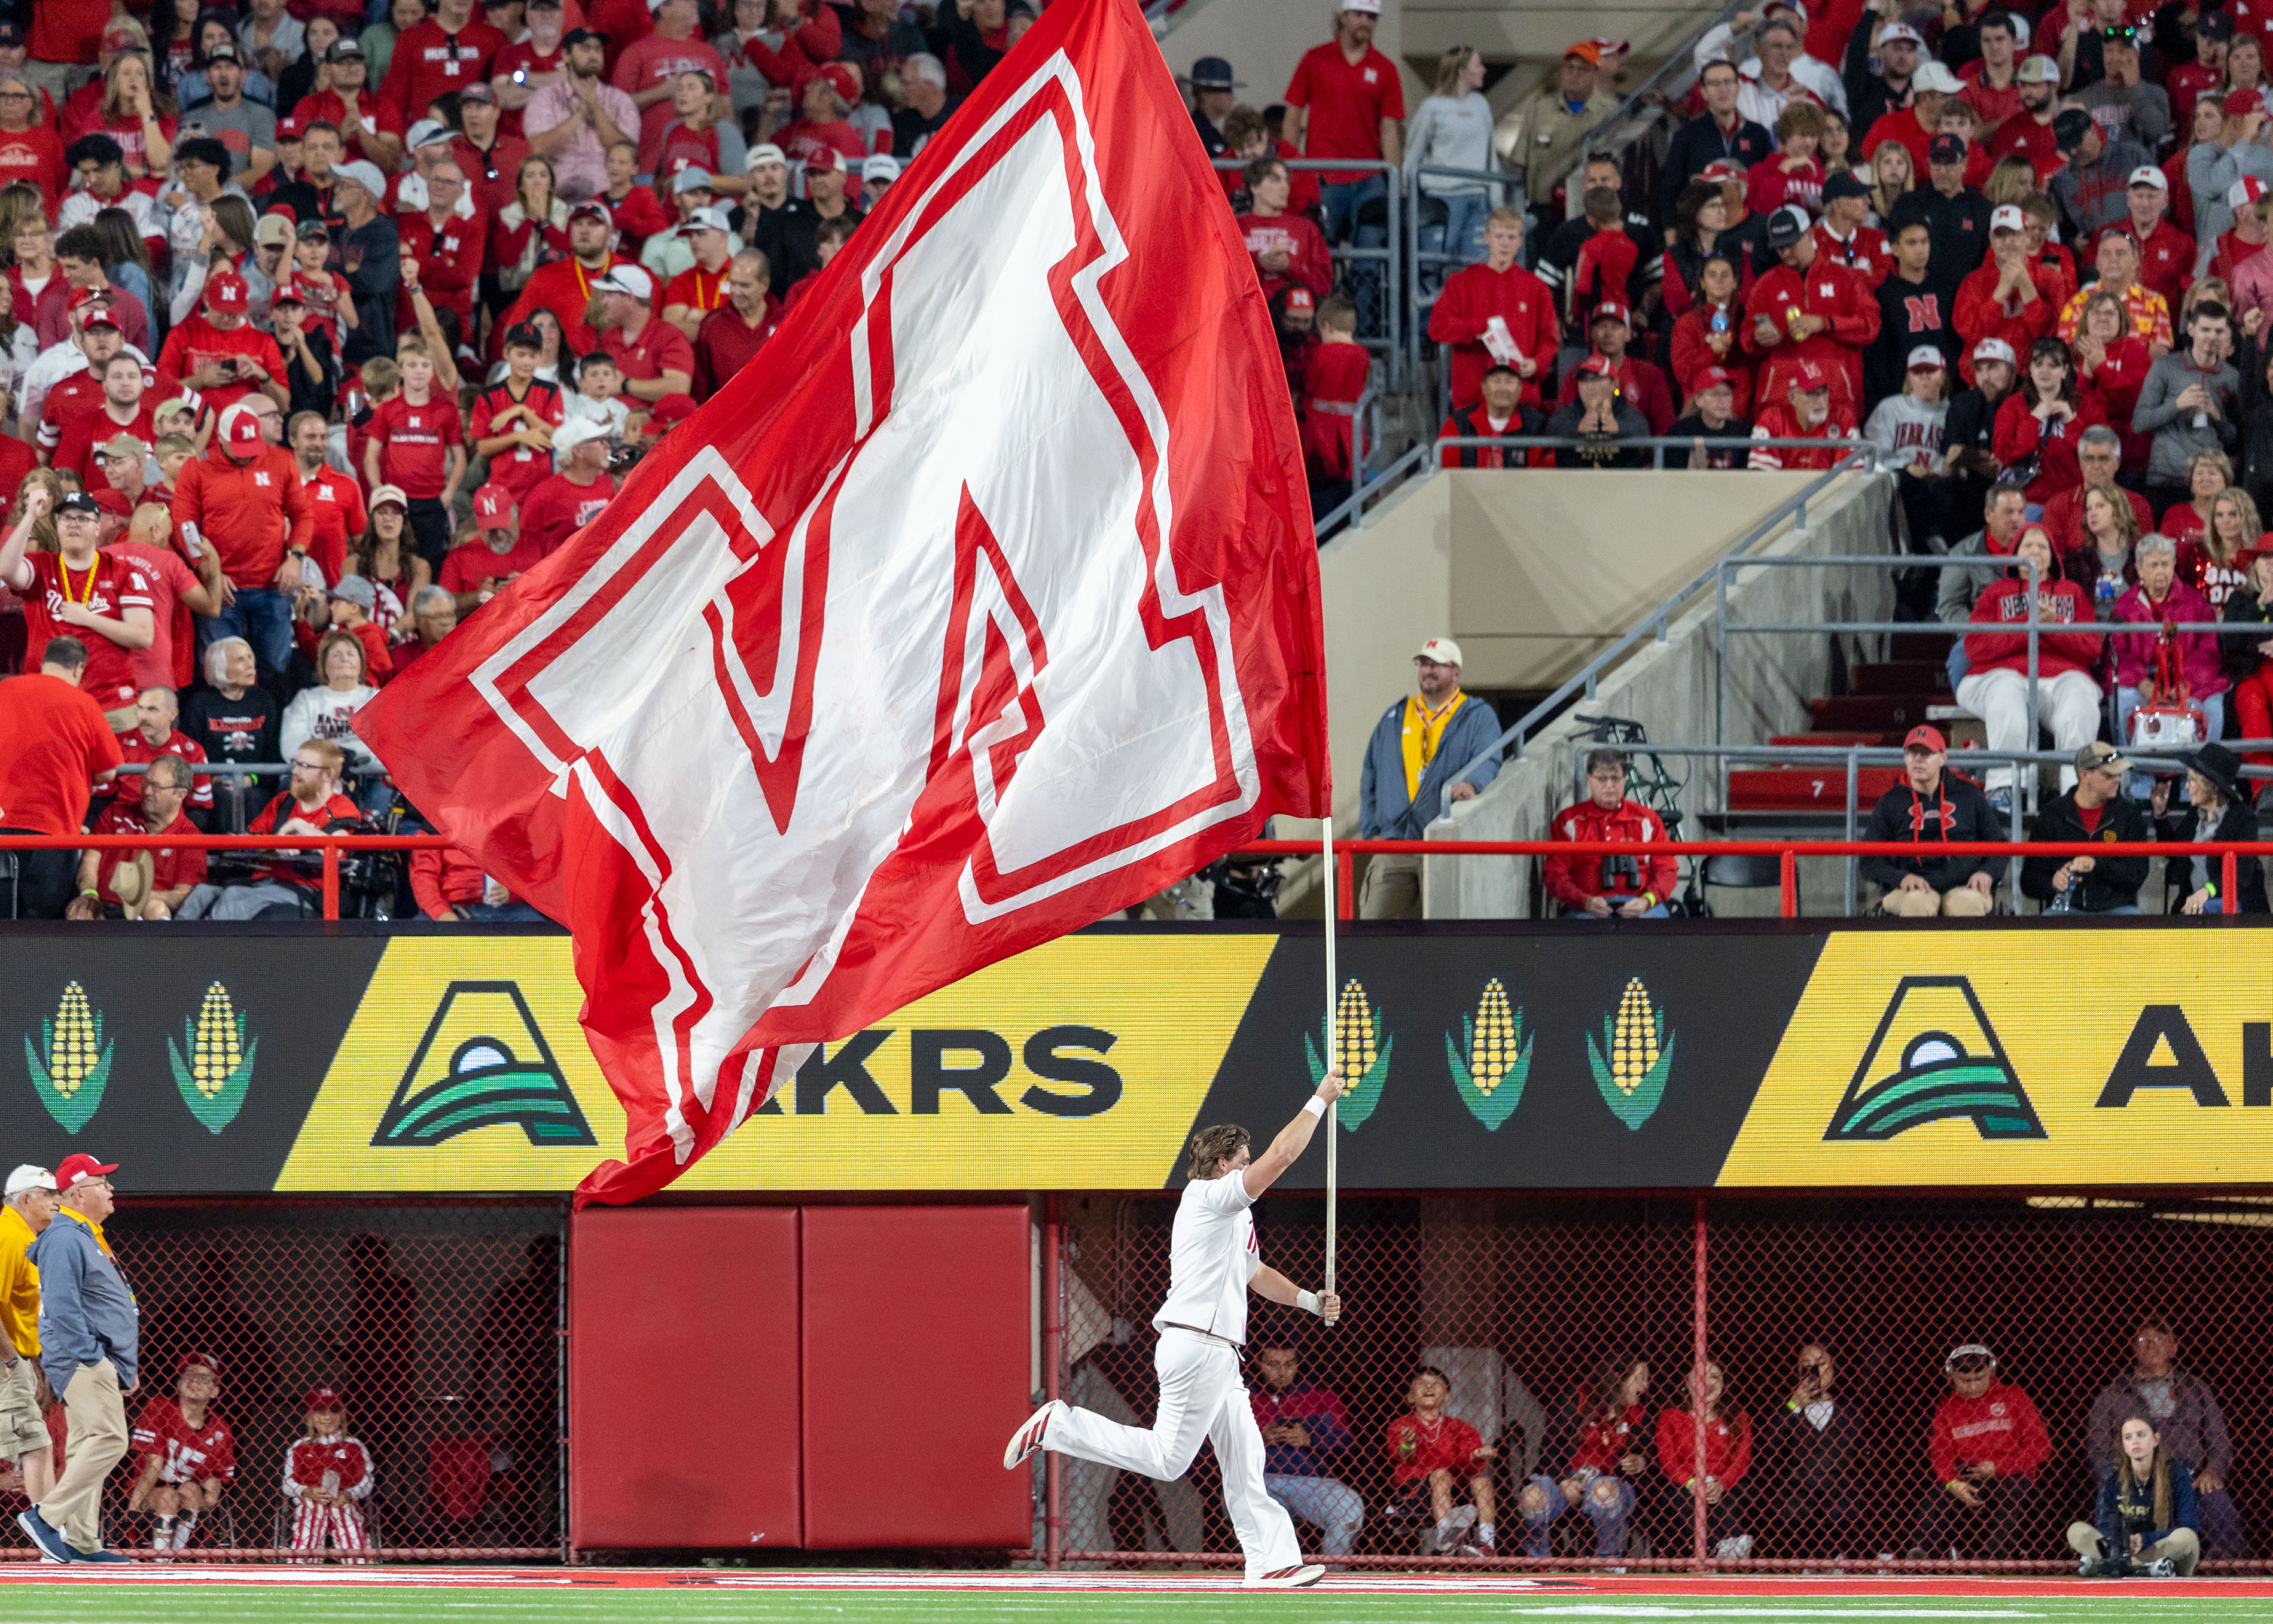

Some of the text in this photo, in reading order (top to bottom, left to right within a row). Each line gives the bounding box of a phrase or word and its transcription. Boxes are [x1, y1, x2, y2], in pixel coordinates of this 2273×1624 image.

[222, 286, 236, 301] N
[1904, 294, 1942, 333] N
[242, 424, 255, 440] N
[255, 471, 270, 486] N
[483, 498, 497, 515] N
[130, 572, 148, 591] N
[1812, 780, 1824, 798] 7
[755, 1024, 1123, 1118] KRS
